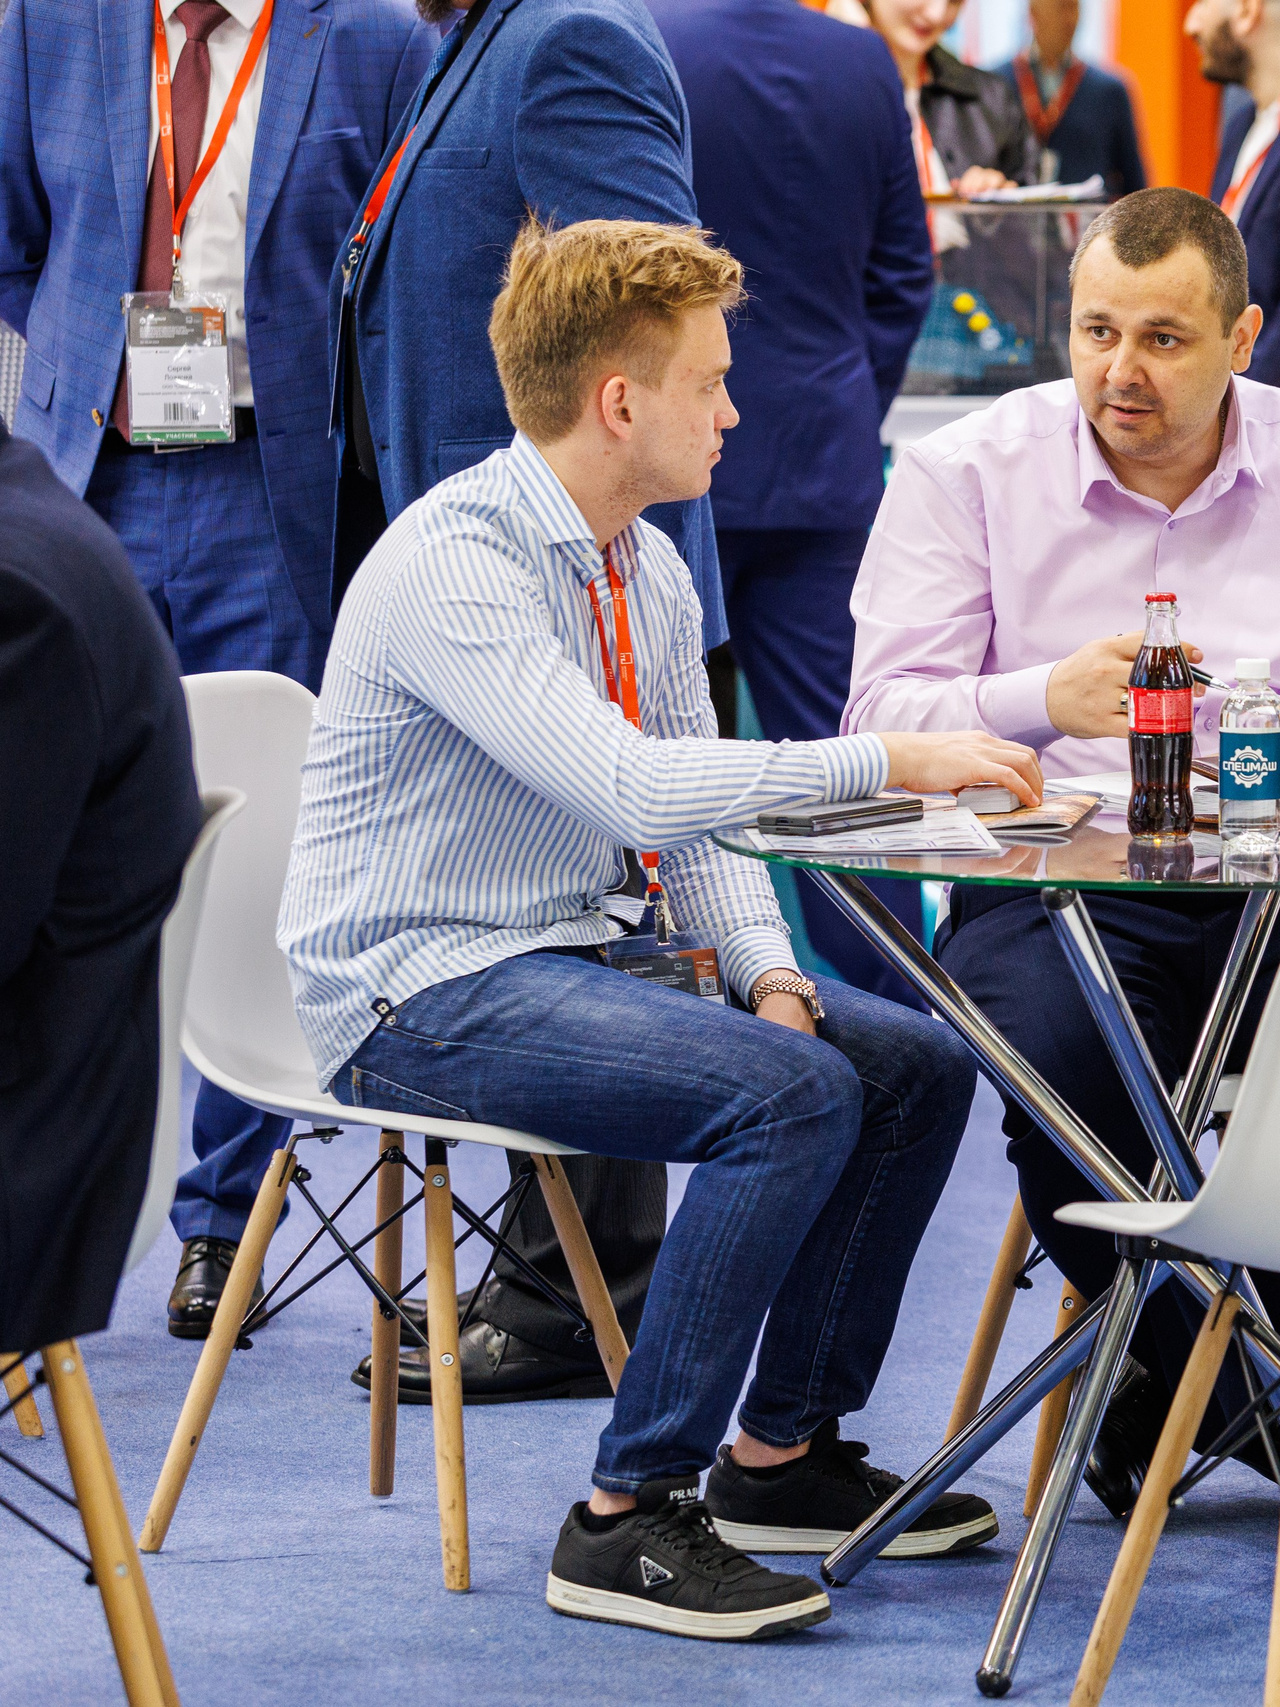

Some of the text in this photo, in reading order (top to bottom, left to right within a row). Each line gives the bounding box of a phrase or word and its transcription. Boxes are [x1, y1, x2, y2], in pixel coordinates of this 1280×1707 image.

[165, 432, 198, 440] УЧАСТНИК
[1222, 760, 1278, 773] СПЕЦМАШ
[669, 1487, 698, 1501] PRAD
